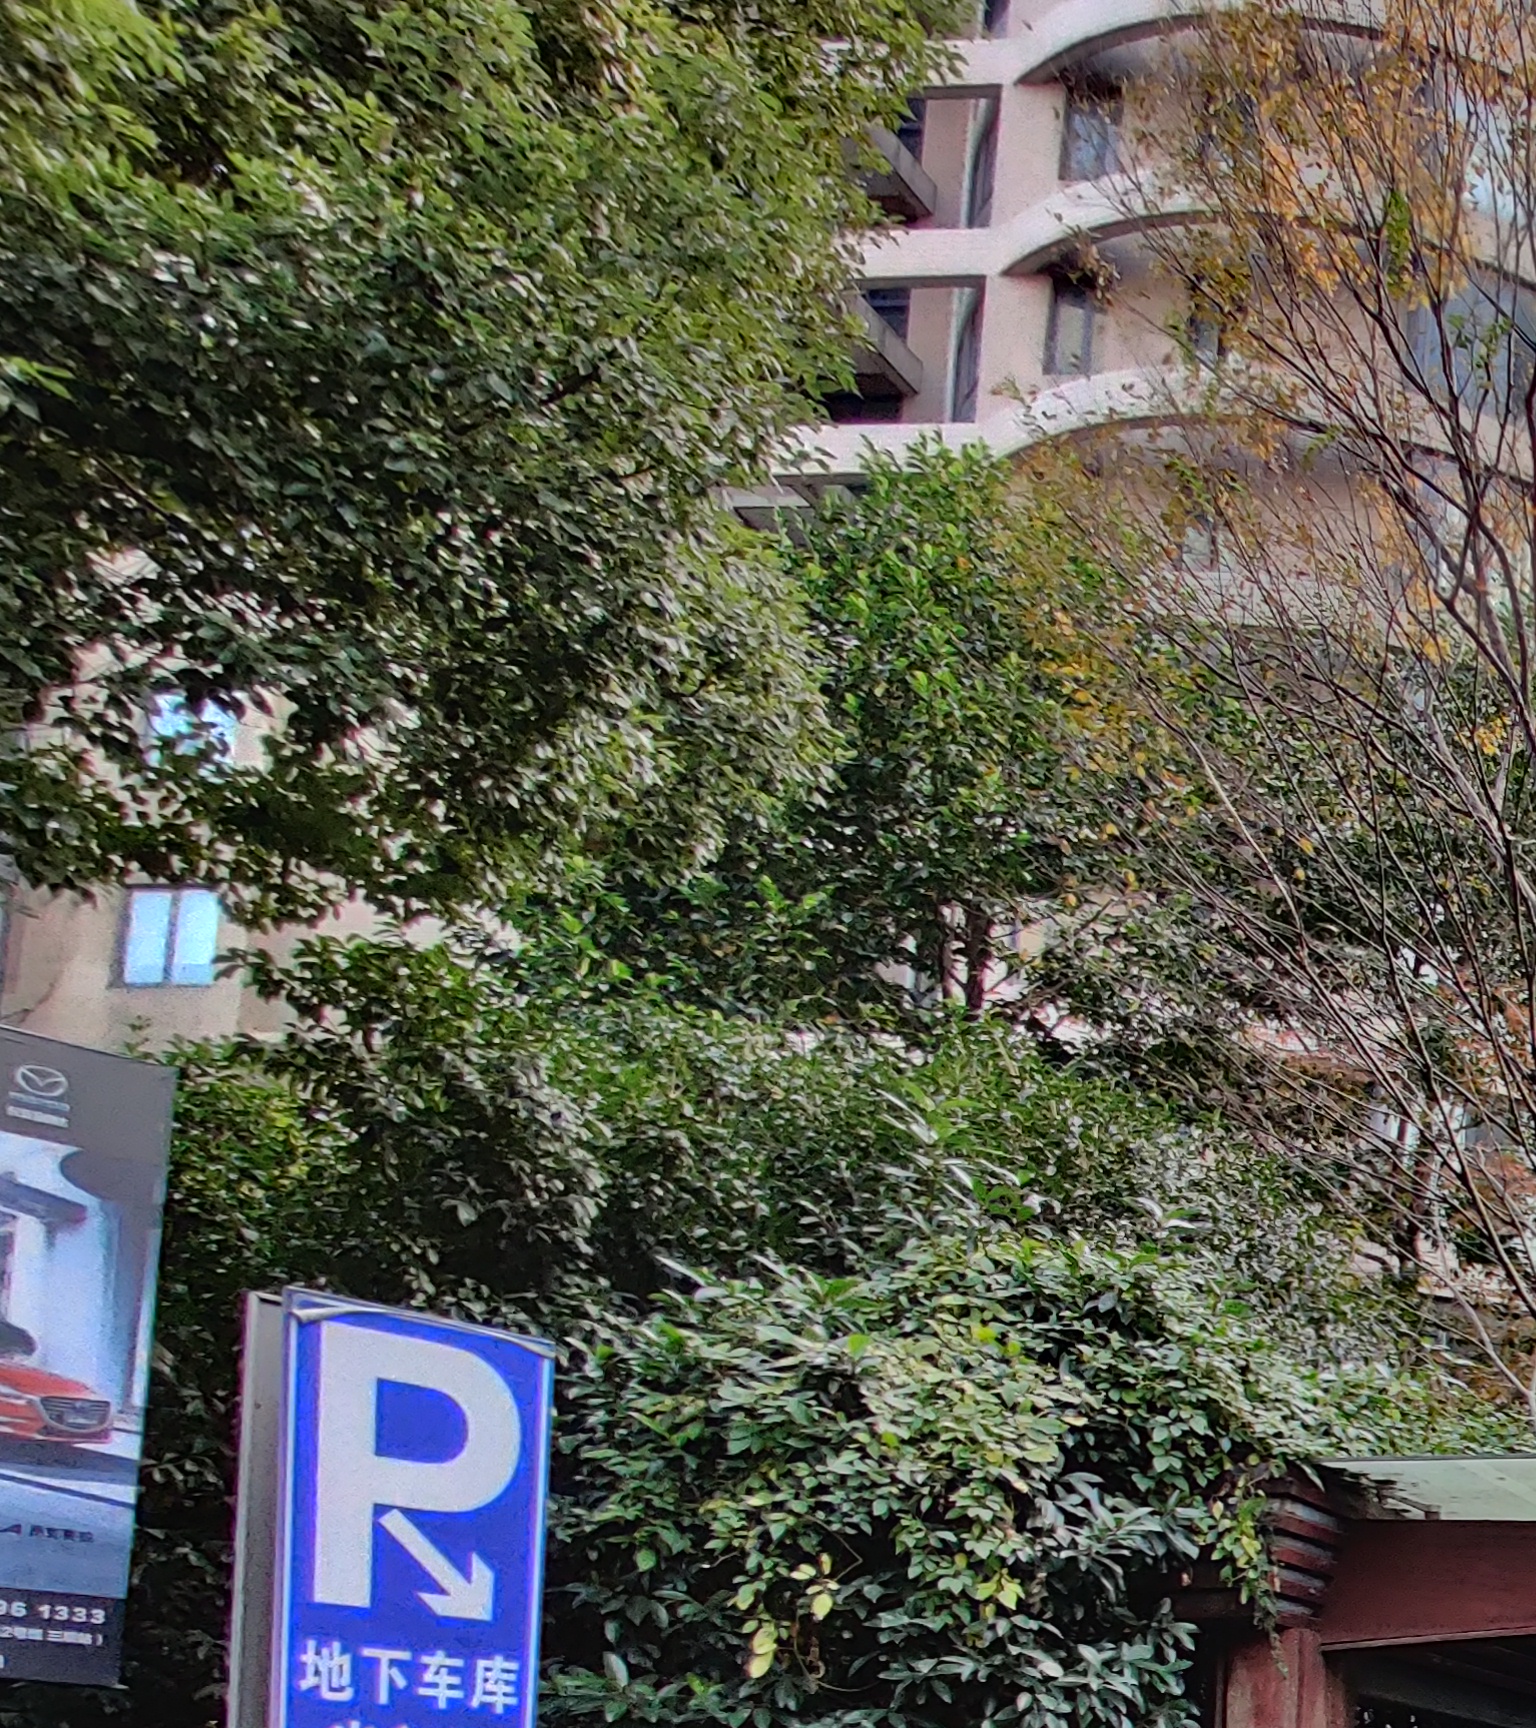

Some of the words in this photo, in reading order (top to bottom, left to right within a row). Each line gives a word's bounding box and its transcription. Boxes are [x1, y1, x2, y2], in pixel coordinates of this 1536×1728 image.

[313, 1320, 521, 1609] P
[38, 1604, 106, 1625] 1333
[298, 1638, 521, 1716] 地下车库
